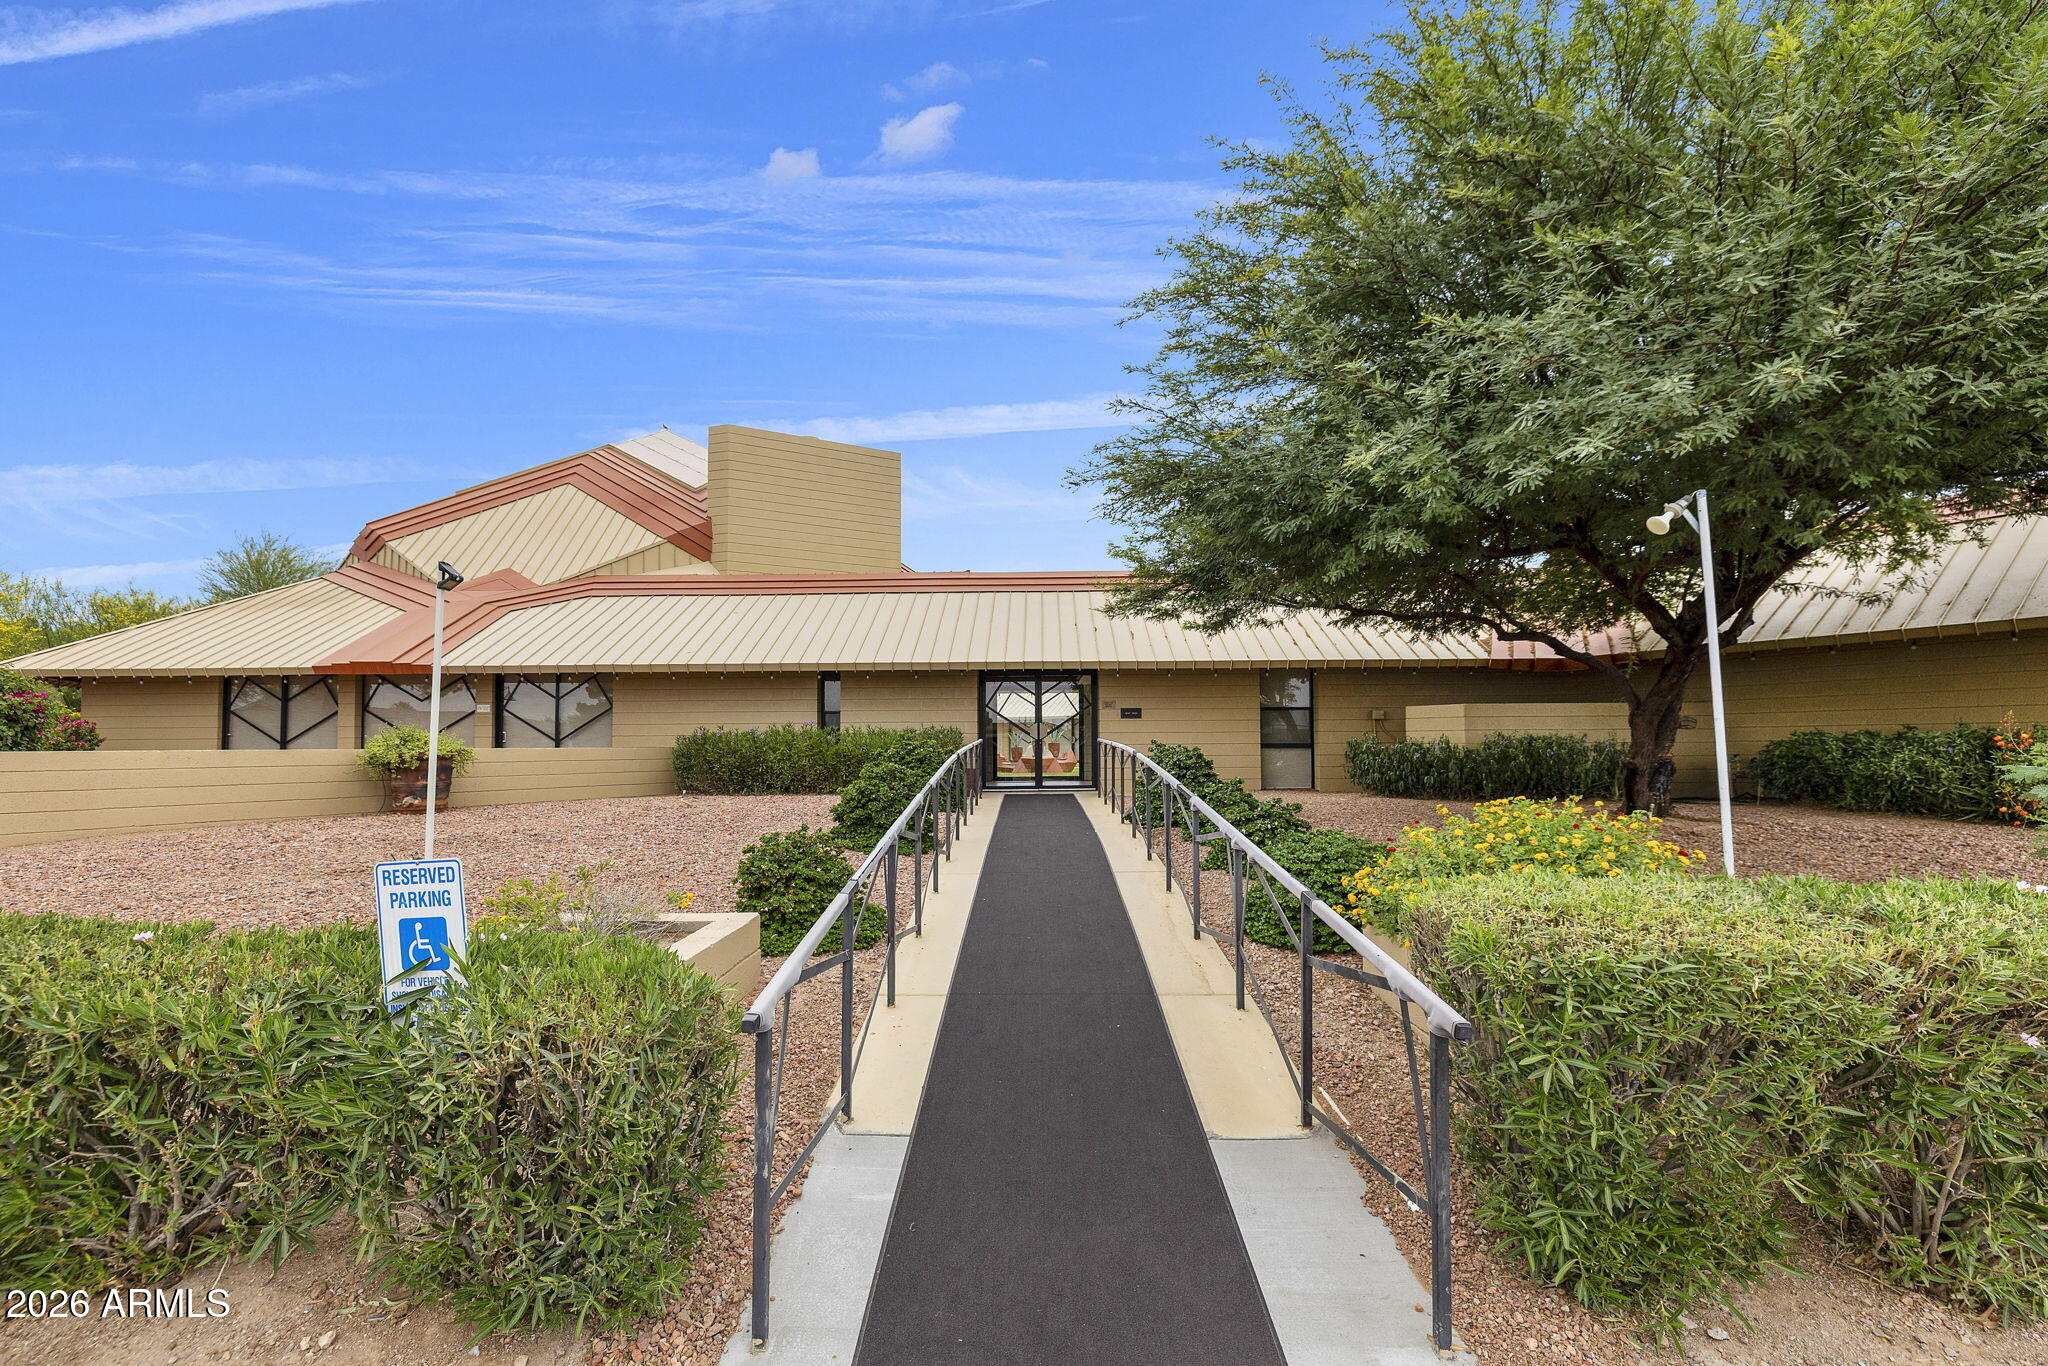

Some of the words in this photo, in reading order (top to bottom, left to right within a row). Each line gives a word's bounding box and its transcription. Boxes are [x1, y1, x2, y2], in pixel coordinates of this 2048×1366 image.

[381, 866, 455, 887] RESERVED
[389, 889, 452, 909] PARKING
[400, 976, 416, 988] FOR
